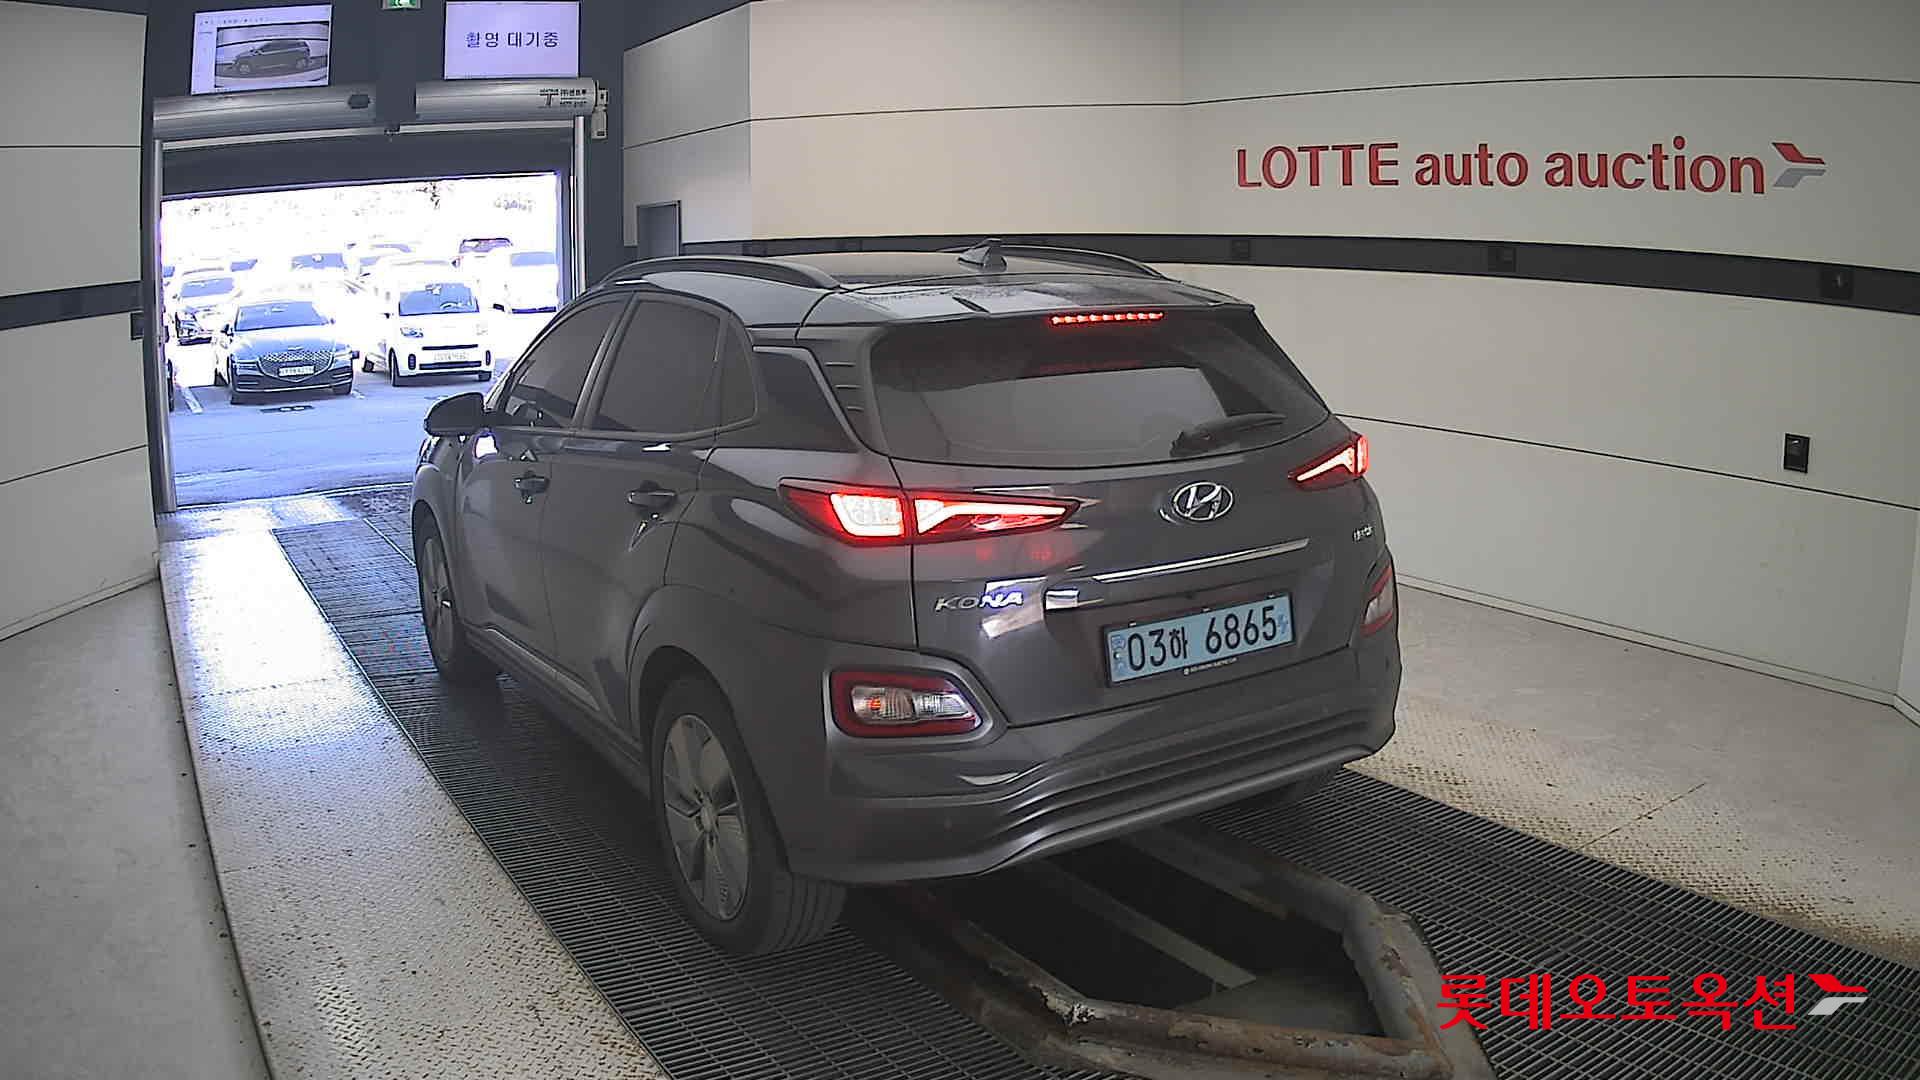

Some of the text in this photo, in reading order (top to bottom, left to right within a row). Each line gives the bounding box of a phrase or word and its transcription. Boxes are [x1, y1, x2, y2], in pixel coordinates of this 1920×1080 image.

[507, 31, 560, 48] 대기중
[1236, 135, 1766, 195] LOTTE auto auction
[935, 591, 1024, 612] KONA
[1127, 604, 1277, 672] 03하 6865
